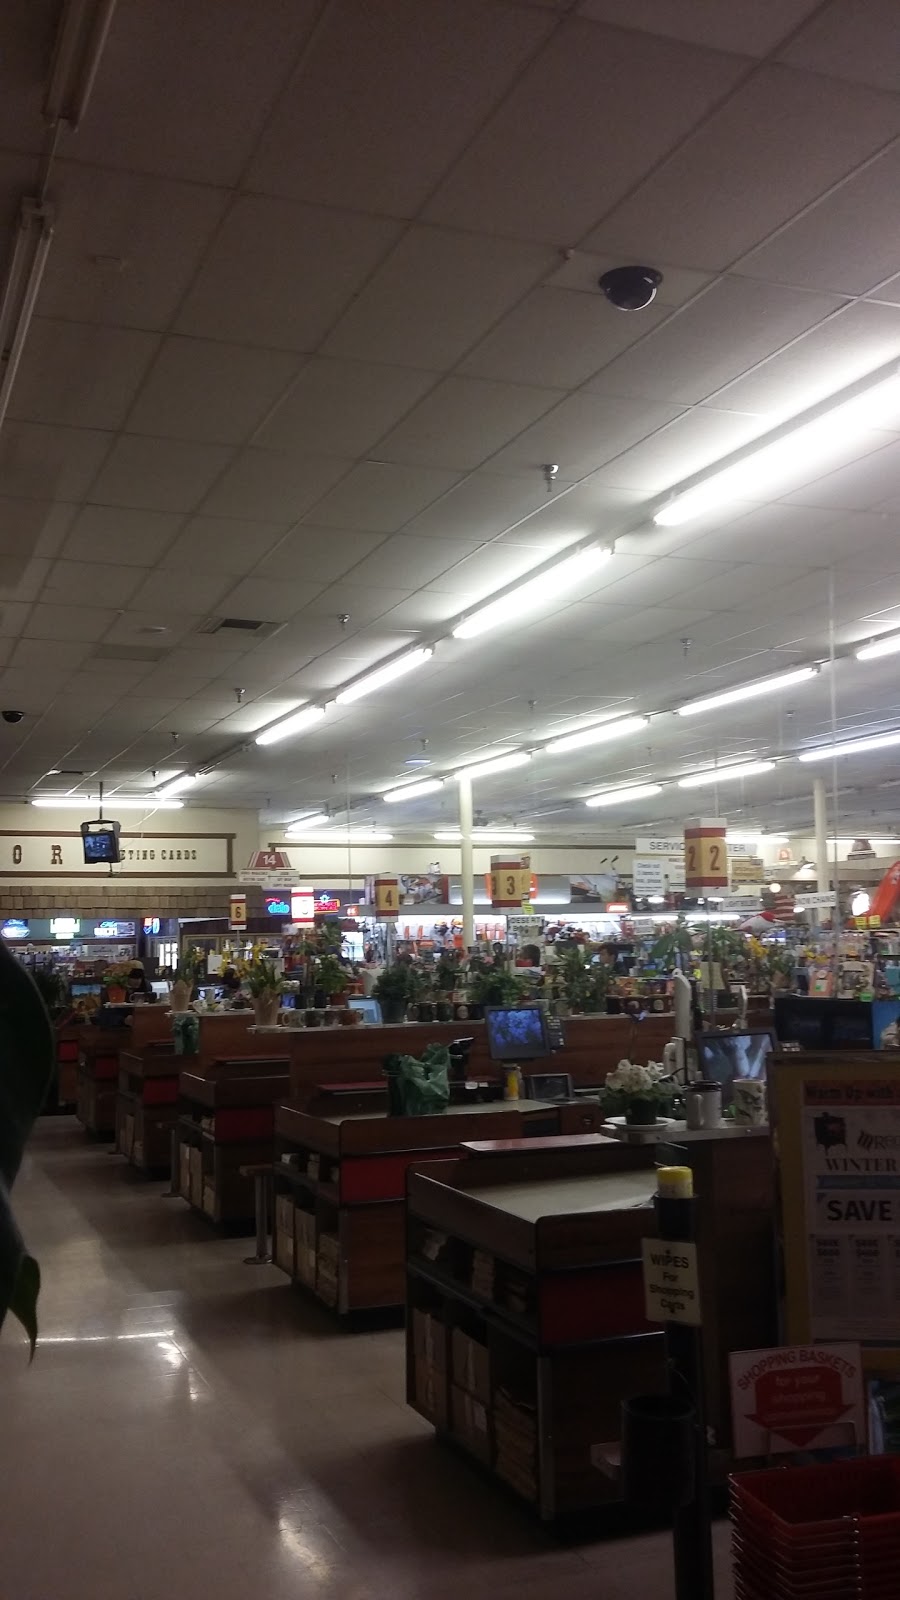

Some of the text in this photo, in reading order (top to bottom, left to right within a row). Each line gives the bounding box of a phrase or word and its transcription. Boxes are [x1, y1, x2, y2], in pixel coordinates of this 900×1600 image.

[160, 849, 197, 861] CARDS
[262, 854, 277, 865] 14
[709, 844, 721, 871] 2
[506, 875, 515, 896] 3
[385, 889, 392, 907] 4
[235, 906, 242, 919] 6
[825, 1157, 897, 1172] WINTER
[826, 1199, 893, 1222] SAVE
[650, 1253, 690, 1269] WIPES
[662, 1271, 678, 1282] For
[649, 1283, 694, 1300] Shopping
[737, 1349, 857, 1391] SHOPPING BASKETS
